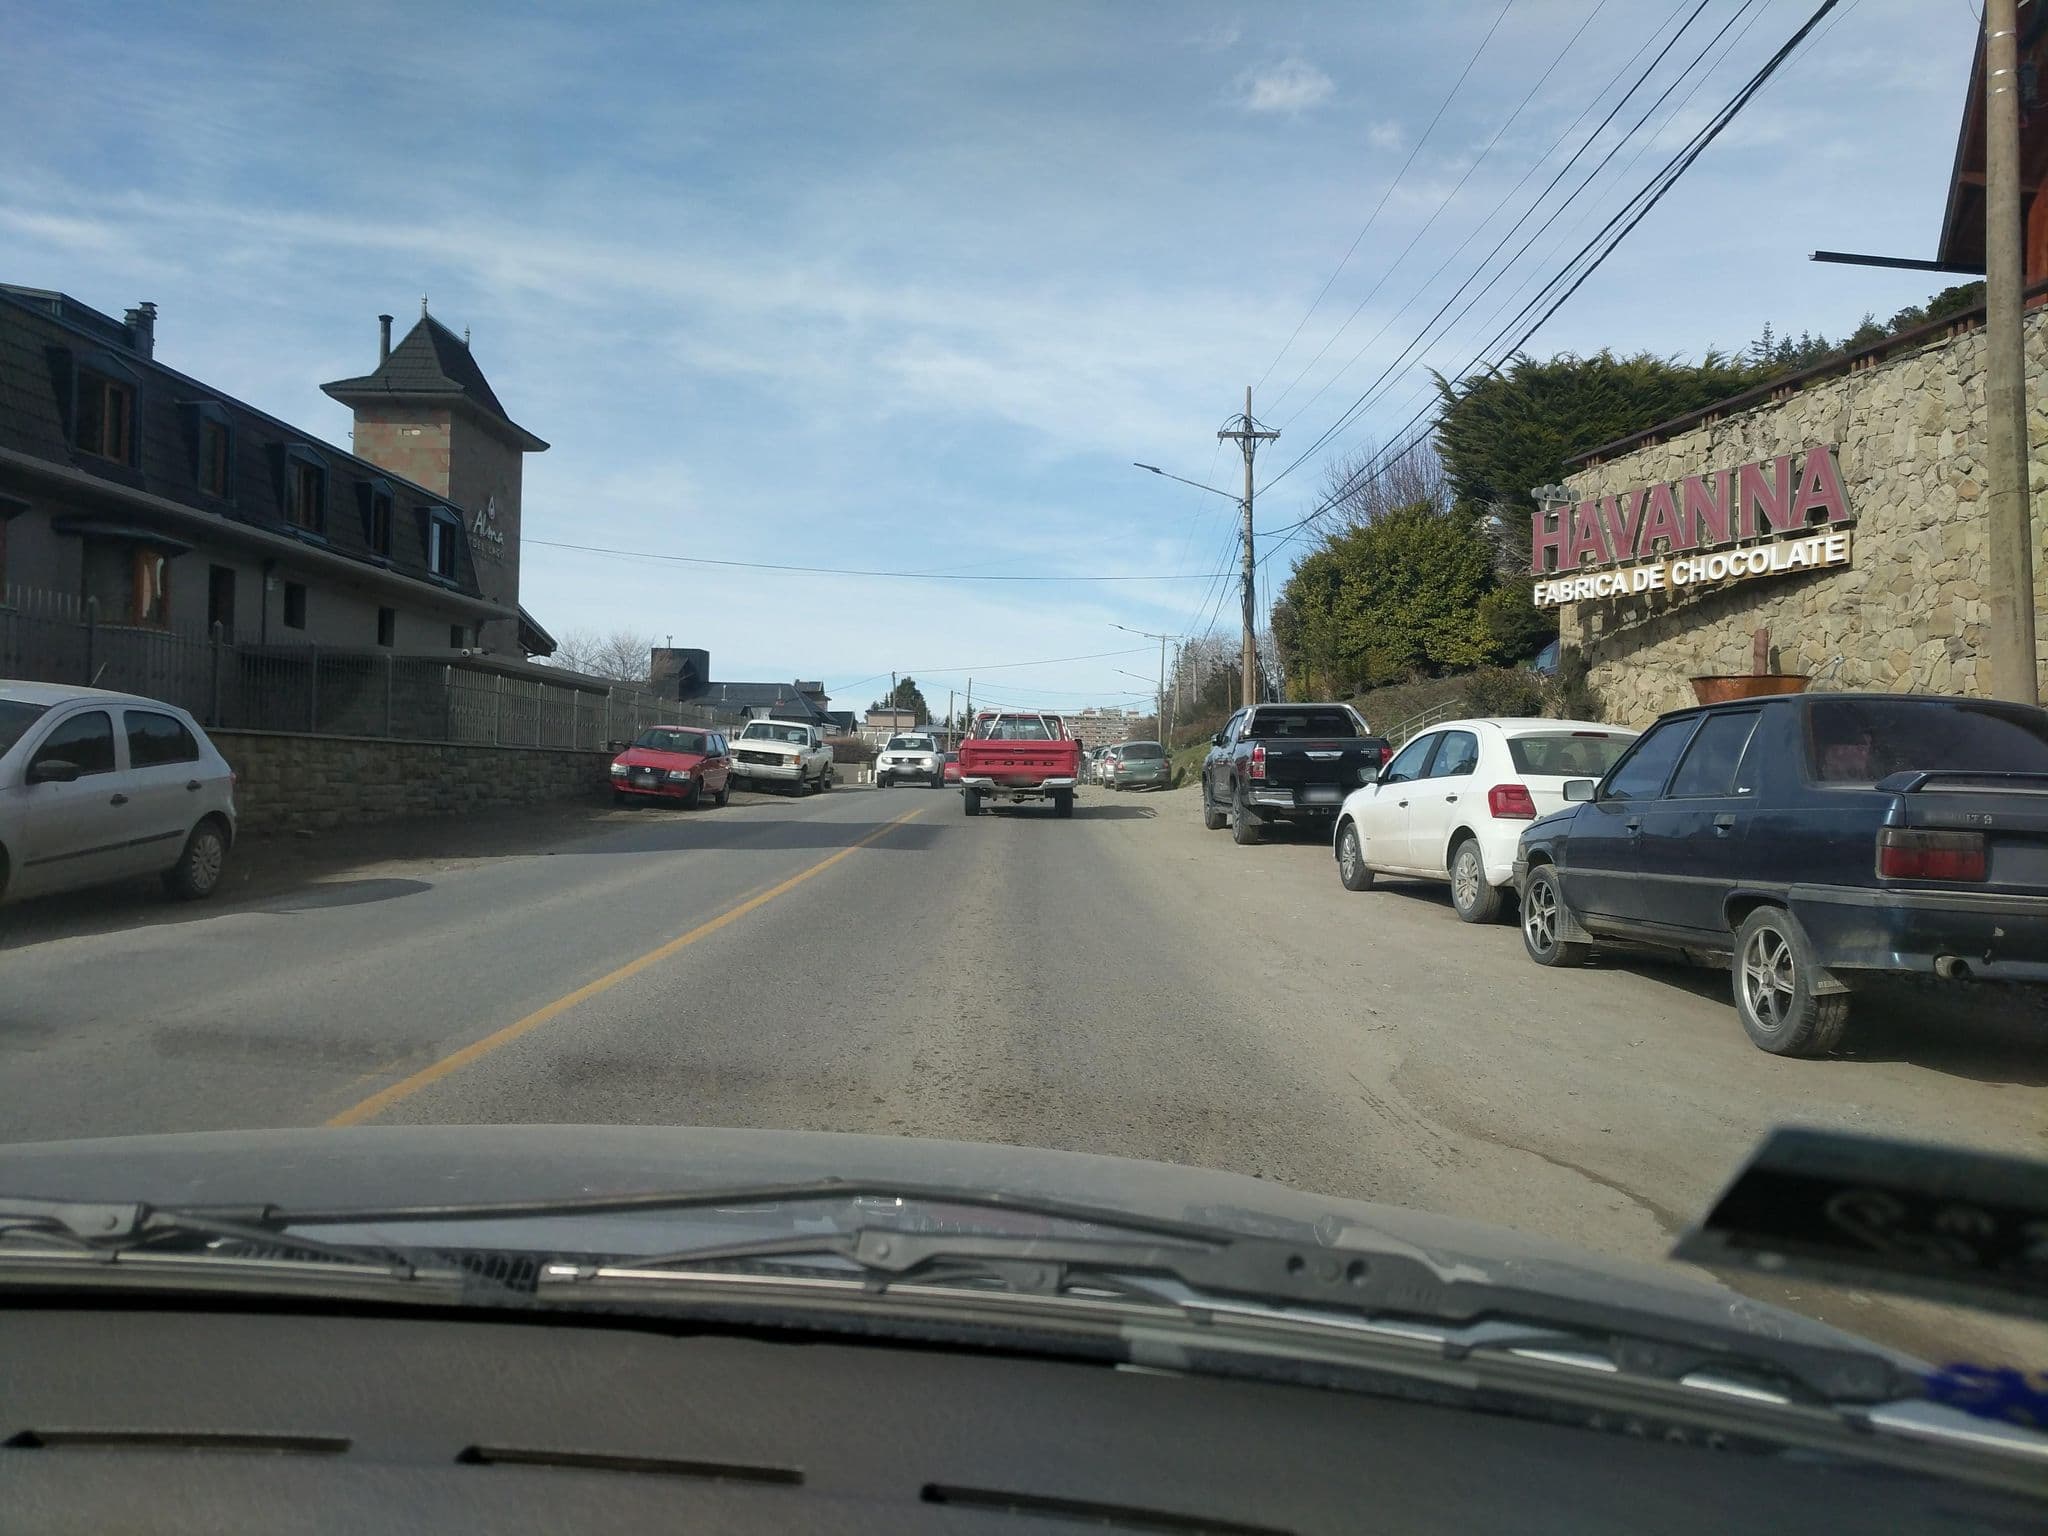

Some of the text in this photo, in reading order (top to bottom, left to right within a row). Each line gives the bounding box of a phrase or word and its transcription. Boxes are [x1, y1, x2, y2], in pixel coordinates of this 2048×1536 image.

[473, 510, 504, 545] Alma
[1531, 445, 1853, 576] HAVANNA
[1533, 534, 1847, 606] FABRICA DE CHOCOLATE
